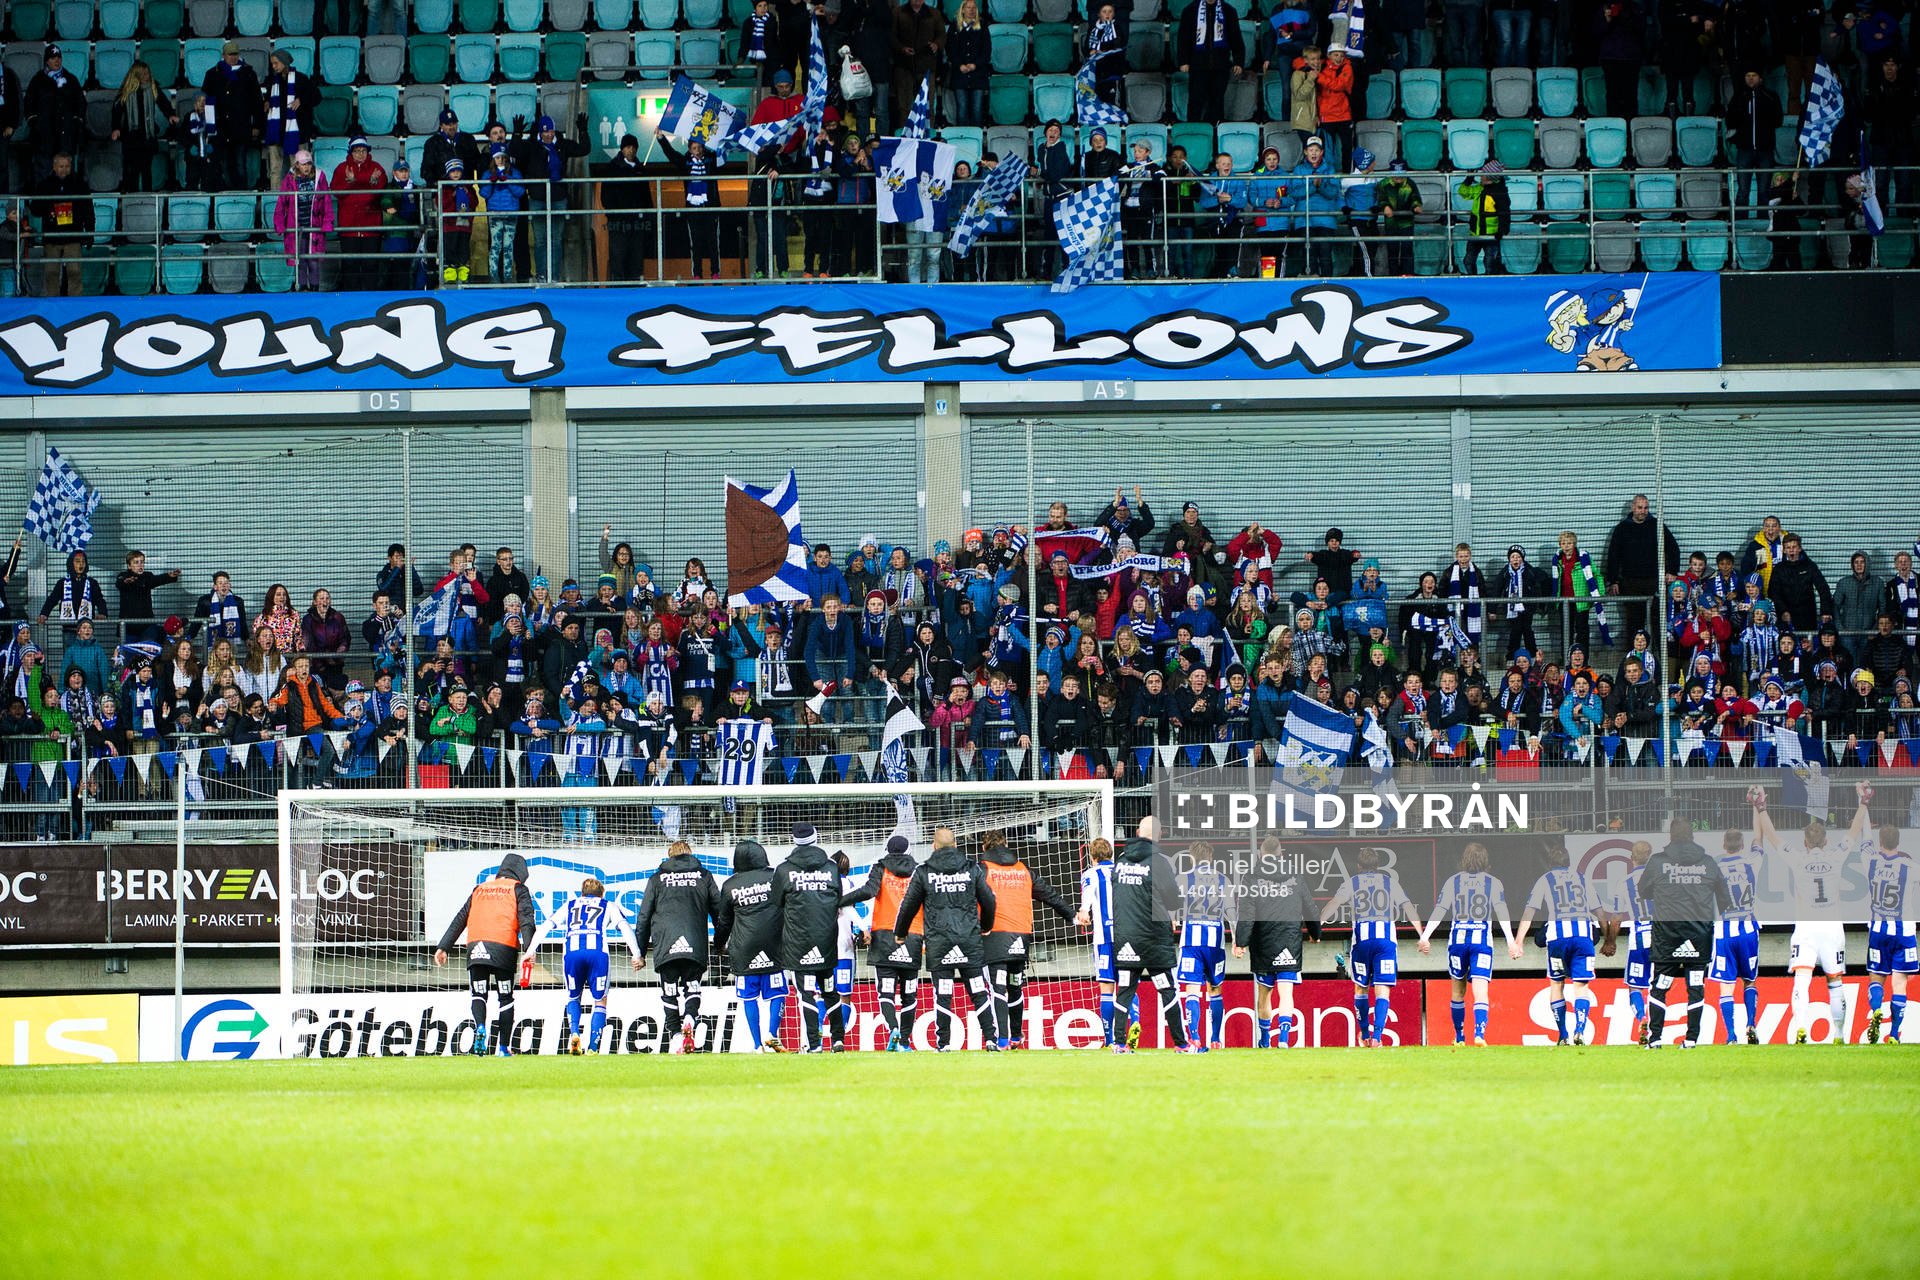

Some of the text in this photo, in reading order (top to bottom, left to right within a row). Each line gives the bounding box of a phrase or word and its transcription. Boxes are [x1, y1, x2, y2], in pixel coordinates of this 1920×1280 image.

[724, 738, 756, 762] 29
[96, 869, 220, 902] BERRY
[1555, 884, 1585, 909] 13
[1813, 878, 1828, 903] 1
[1871, 881, 1900, 911] 15
[1355, 889, 1389, 913] 30
[1456, 894, 1487, 920] 18
[200, 913, 264, 926] PARKETT
[274, 913, 315, 926] KICK
[320, 913, 362, 926] VINYL
[570, 906, 603, 927] 17
